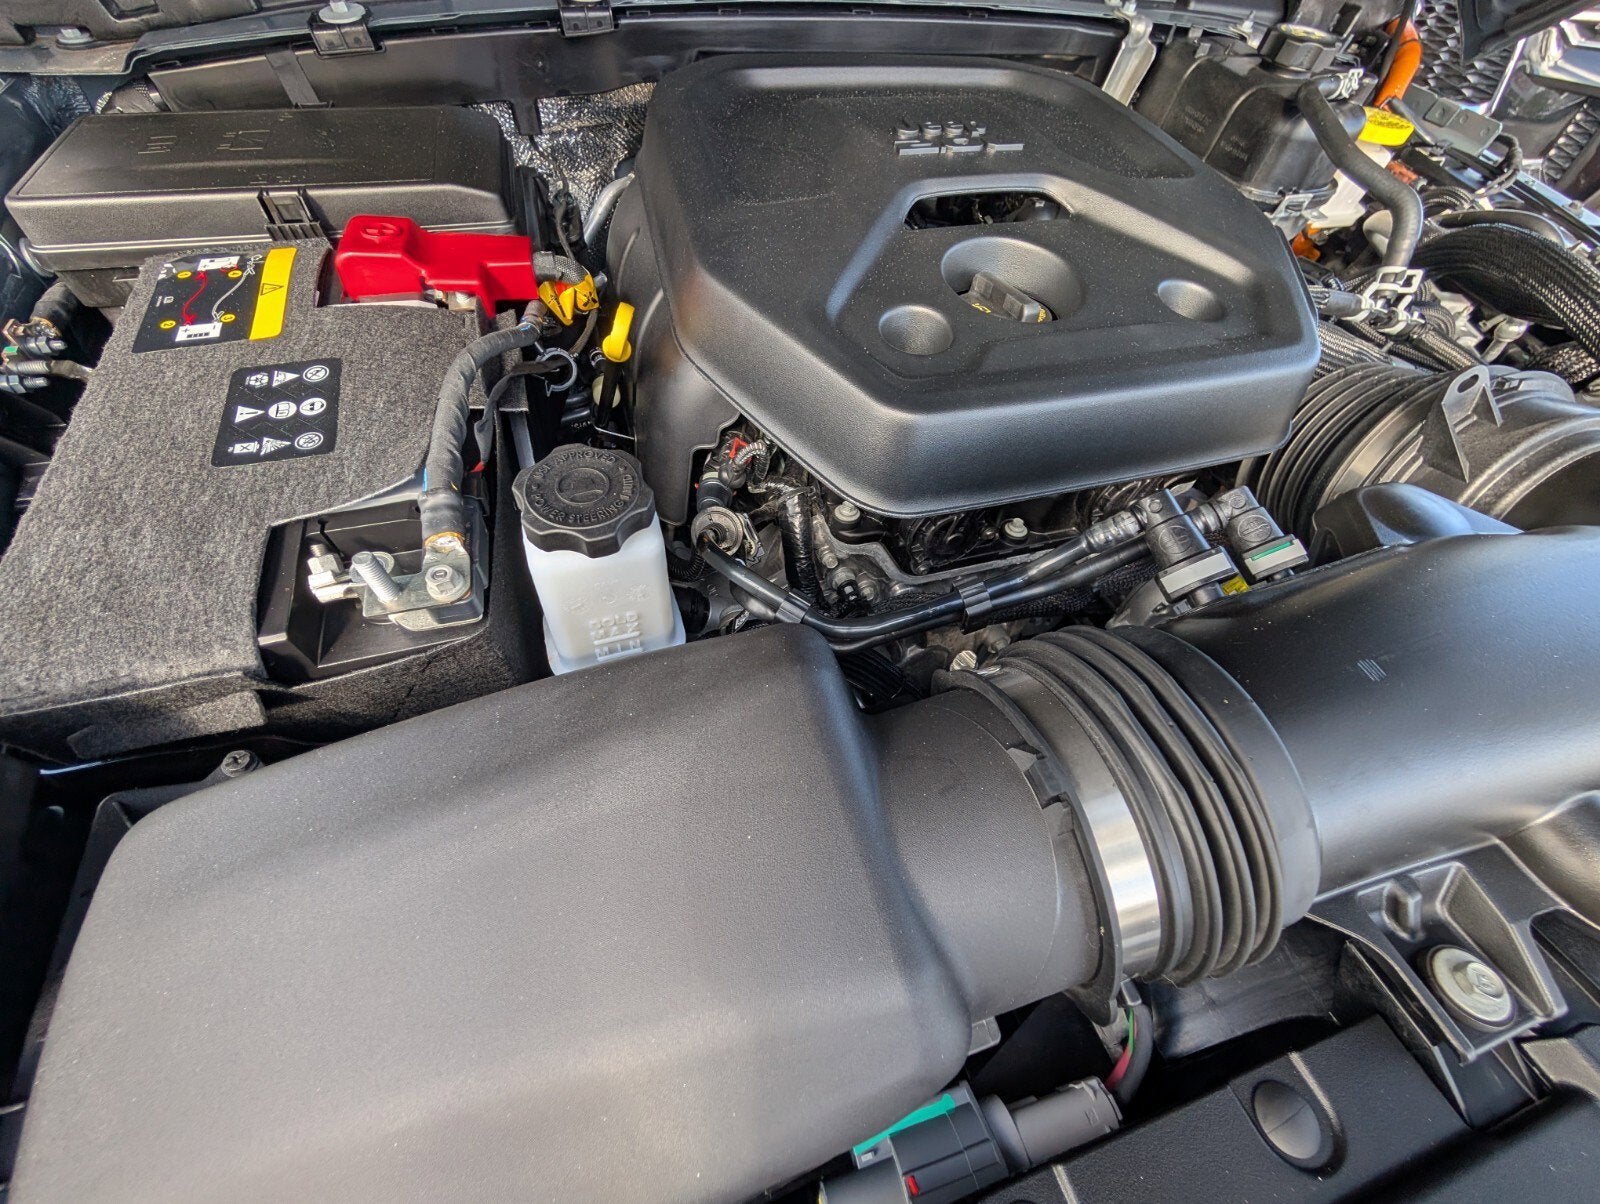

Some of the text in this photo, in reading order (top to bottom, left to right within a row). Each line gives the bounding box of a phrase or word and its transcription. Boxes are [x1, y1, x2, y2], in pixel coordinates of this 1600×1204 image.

[554, 451, 616, 465] APPROVED
[532, 494, 566, 522] POWER
[568, 499, 625, 524] STEERING
[594, 640, 641, 657] MIN
